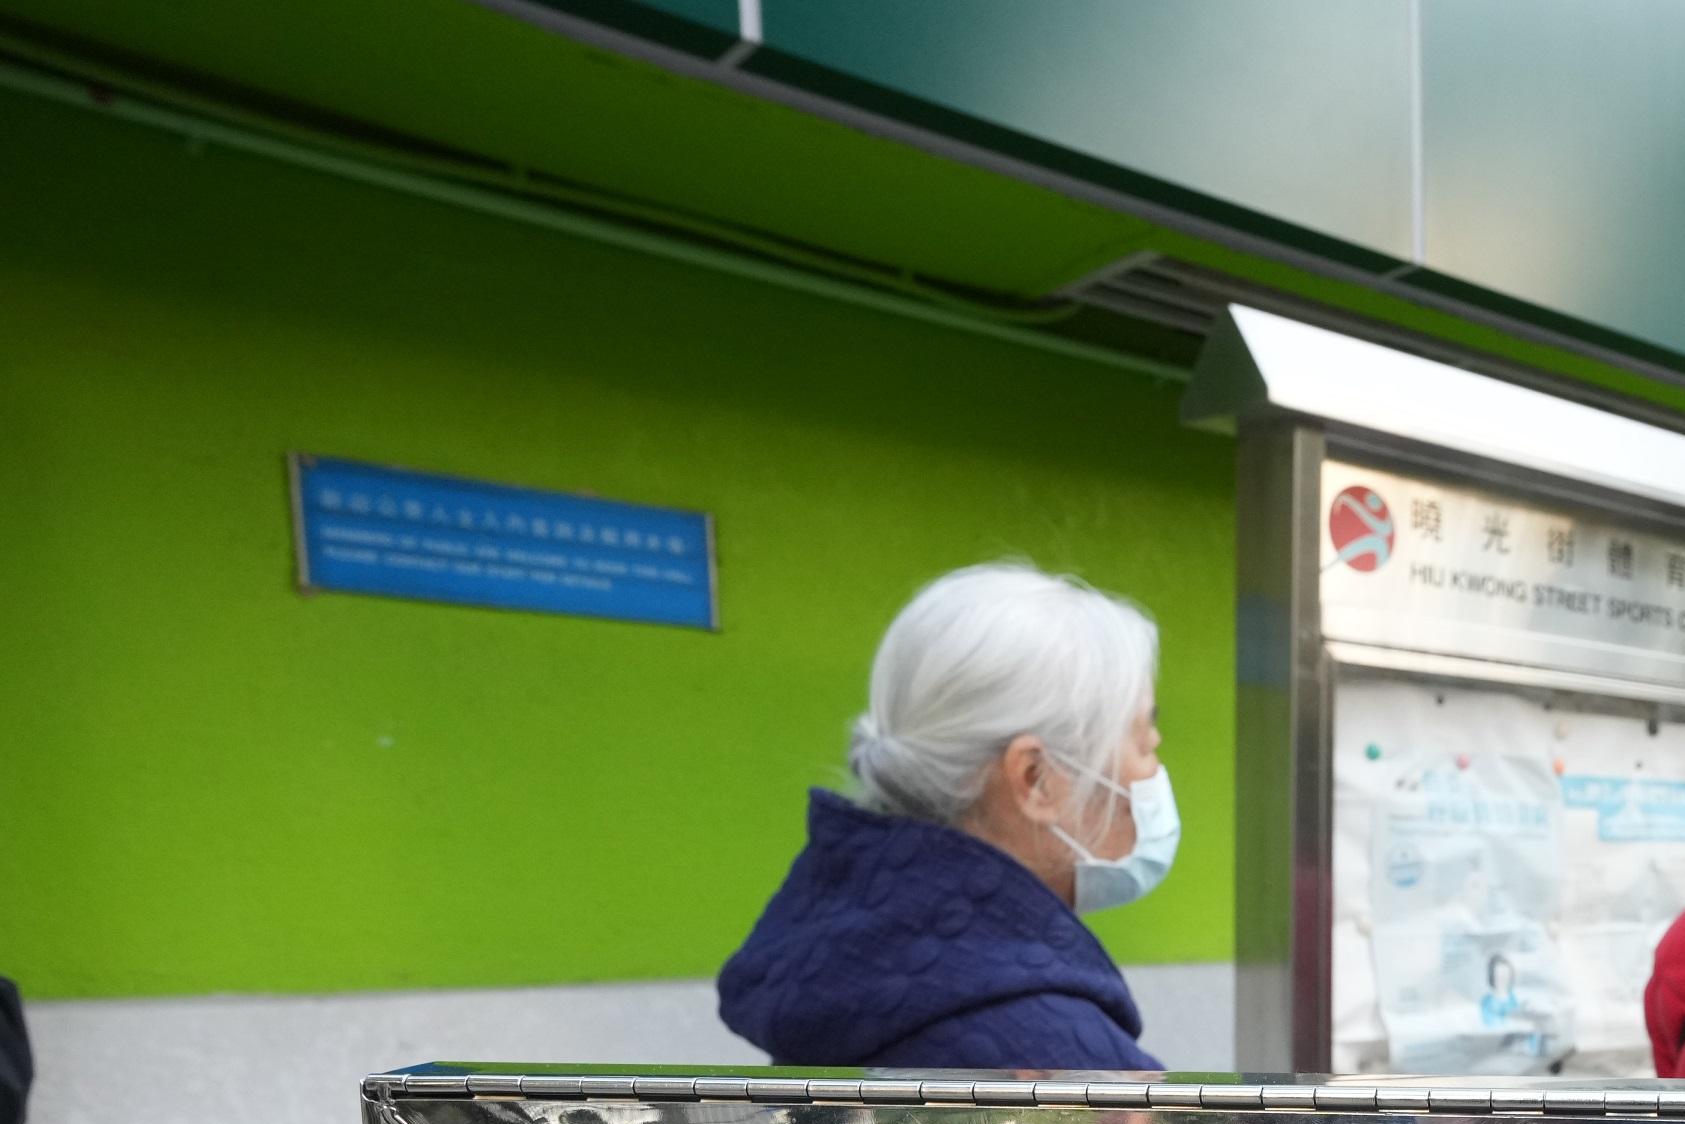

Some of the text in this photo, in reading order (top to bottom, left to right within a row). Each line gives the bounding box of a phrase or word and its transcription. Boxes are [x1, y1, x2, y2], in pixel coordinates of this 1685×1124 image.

[1409, 562, 1445, 589] HIU
[1450, 572, 1528, 604] KWONG
[1532, 583, 1602, 617] STREET
[1607, 596, 1673, 630] SPORTS
